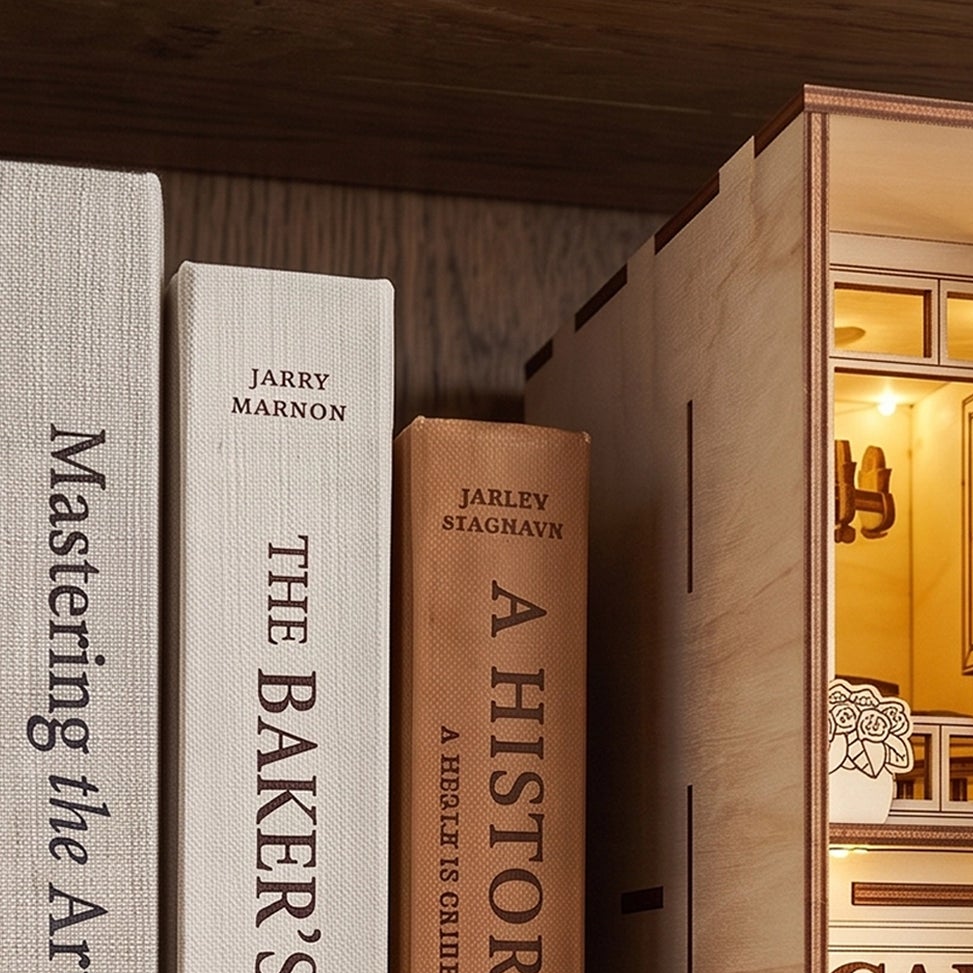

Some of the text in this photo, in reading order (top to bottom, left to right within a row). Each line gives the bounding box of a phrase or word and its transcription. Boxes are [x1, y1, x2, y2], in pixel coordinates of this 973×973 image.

[231, 396, 347, 422] MARNON
[250, 368, 330, 391] JARRY
[27, 423, 106, 754] Mastering
[267, 535, 309, 645] THE
[490, 580, 548, 638] A
[49, 775, 111, 865] the
